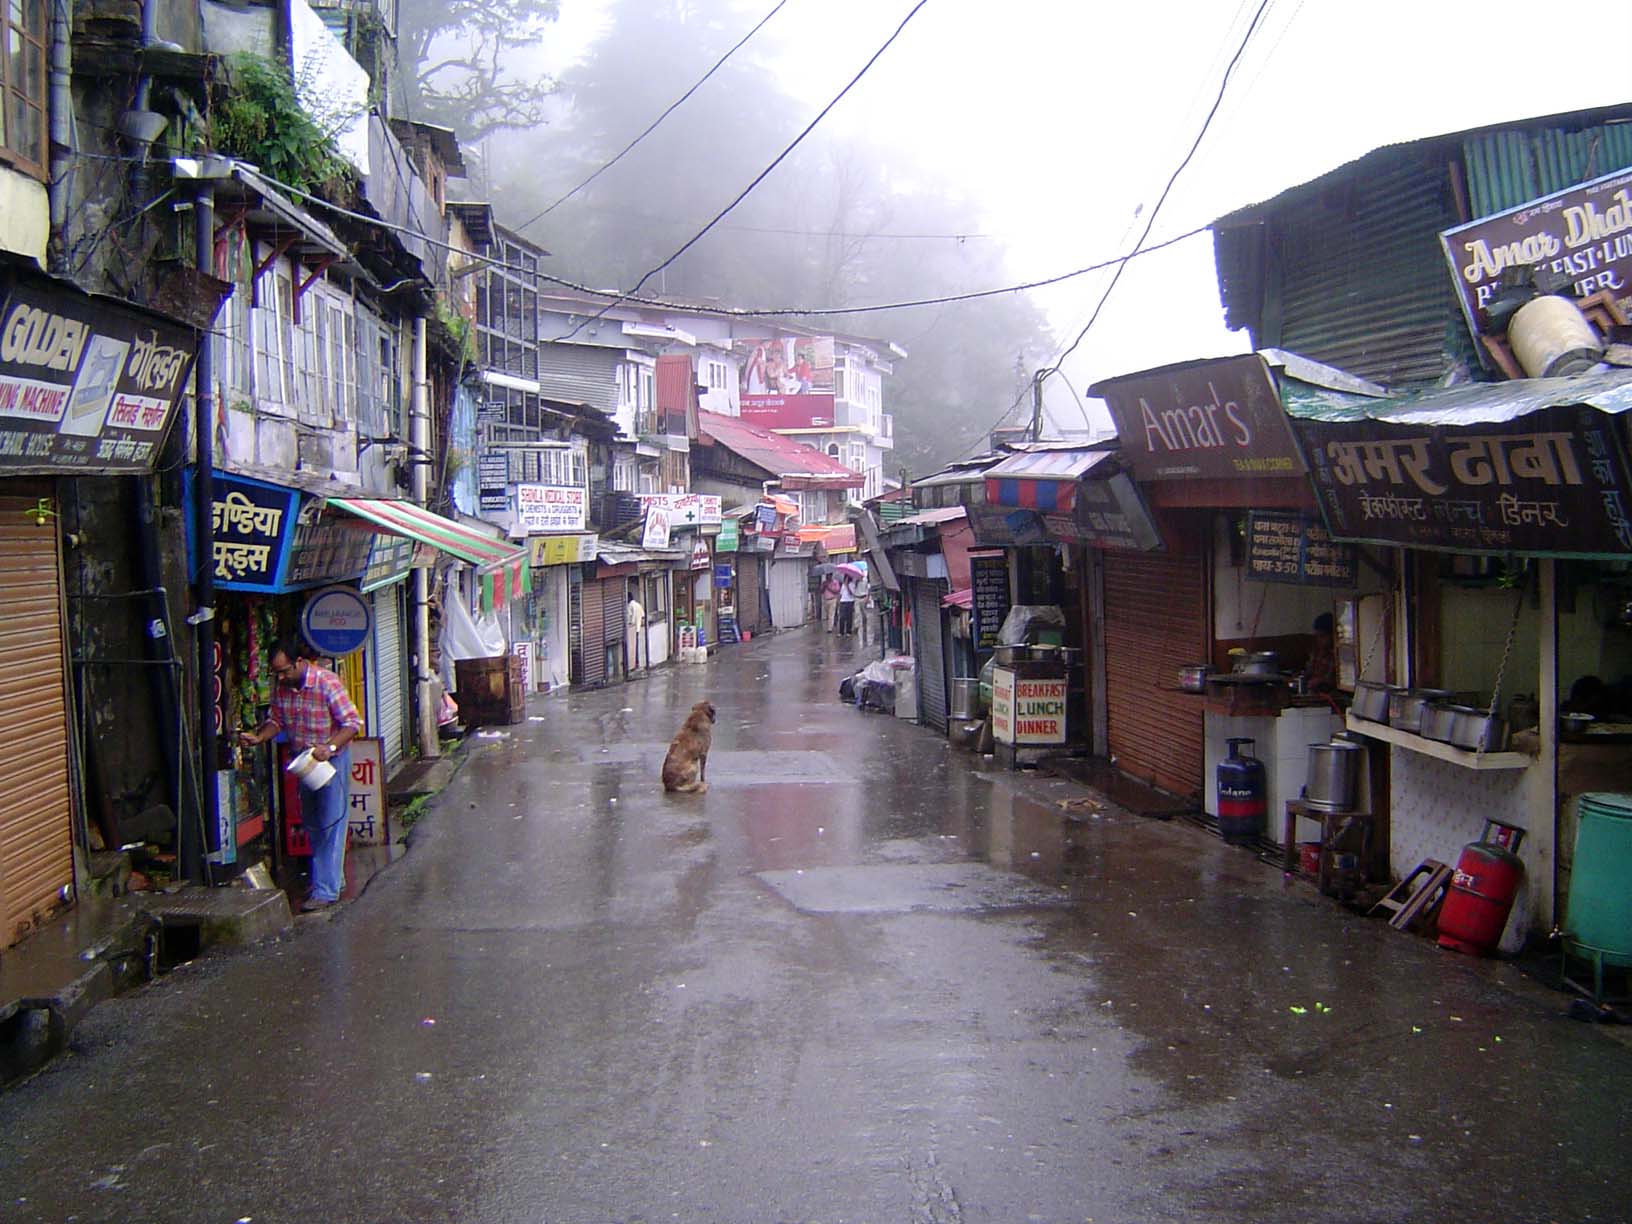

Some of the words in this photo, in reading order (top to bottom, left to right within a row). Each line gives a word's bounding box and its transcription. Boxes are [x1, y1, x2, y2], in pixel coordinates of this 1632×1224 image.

[1464, 232, 1560, 284] Amar
[1, 303, 90, 372] GOLDEN
[128, 329, 192, 393] गोल्डन
[20, 385, 66, 415] MACHINE
[1138, 381, 1250, 452] Amar's
[1326, 436, 1447, 496] अमर
[567, 491, 583, 504] STORE
[640, 496, 668, 506] MISTS
[1496, 493, 1568, 526] डिनर
[1016, 683, 1067, 699] BREAKFAST
[1018, 701, 1064, 716] LUNCH
[1016, 719, 1058, 735] DINNER
